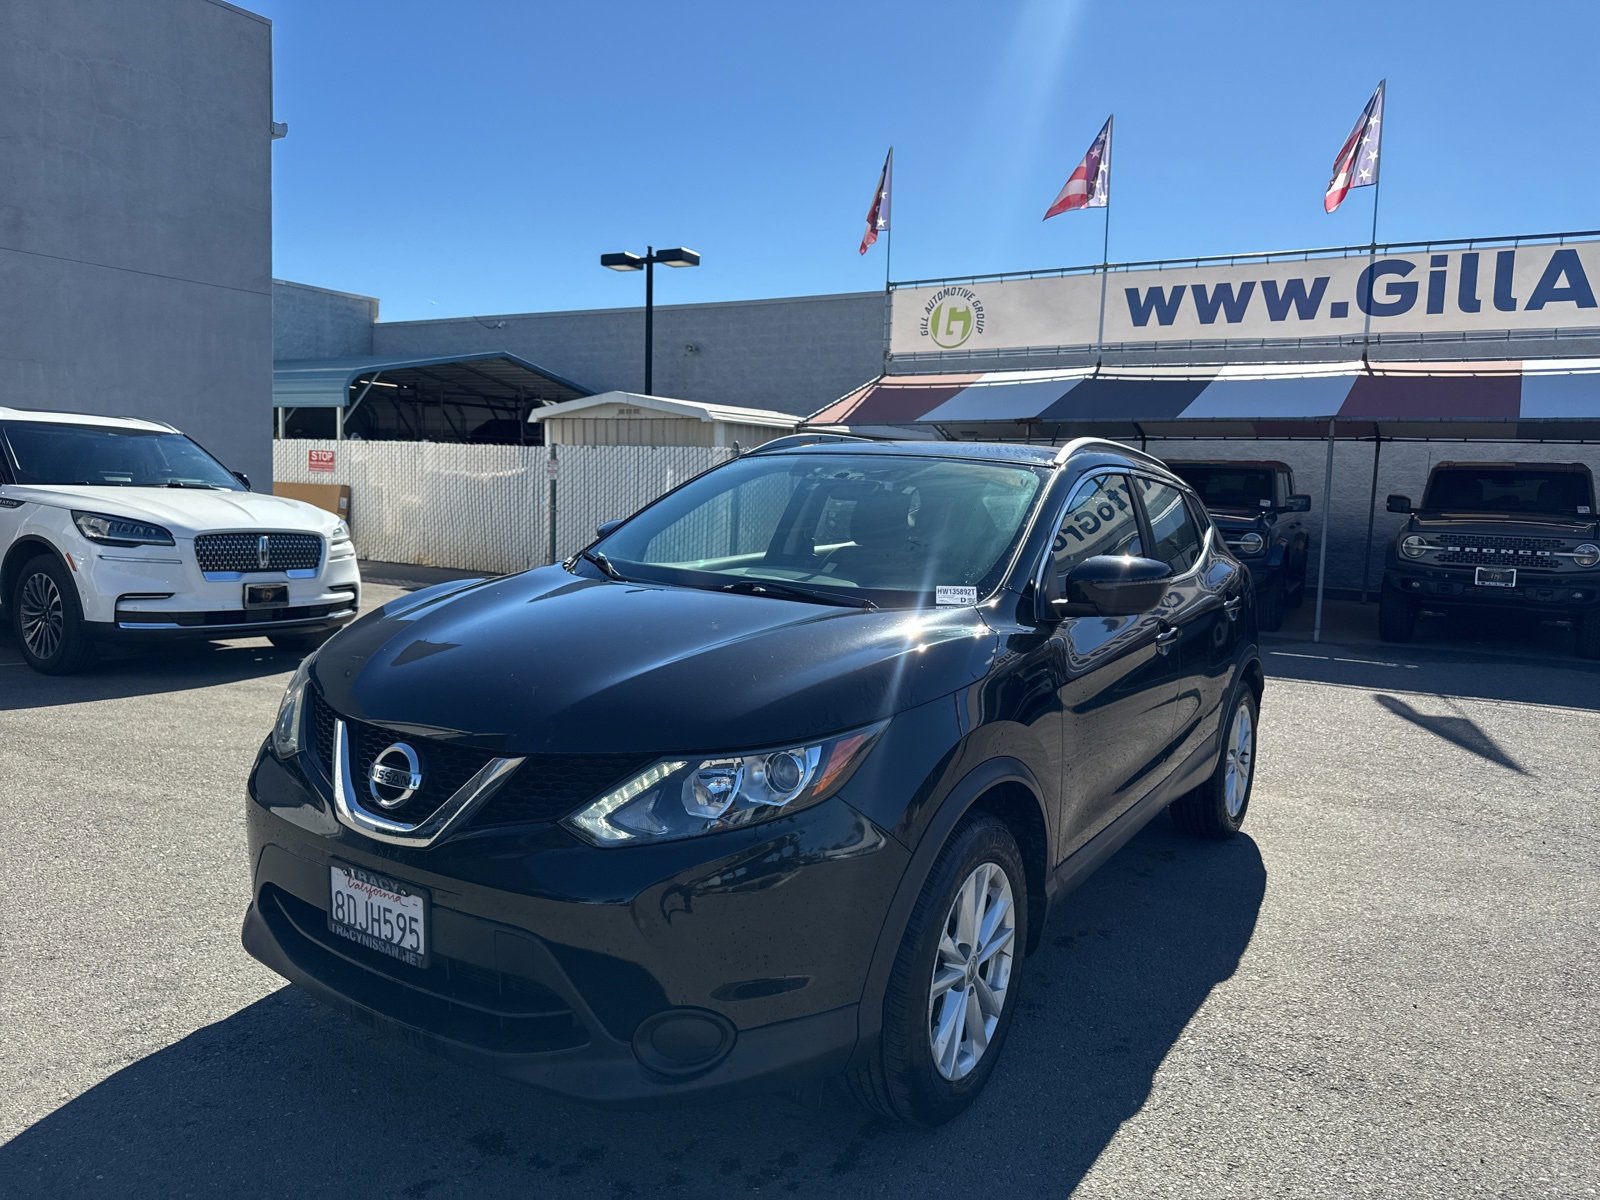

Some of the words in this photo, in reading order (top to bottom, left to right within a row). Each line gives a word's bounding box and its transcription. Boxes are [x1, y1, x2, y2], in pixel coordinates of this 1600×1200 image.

[924, 286, 976, 315] AUTOMOTIVE
[920, 316, 929, 337] GILL
[971, 300, 985, 335] GROUP
[311, 451, 333, 461] STOP
[1447, 546, 1550, 556] BRONCO
[371, 767, 412, 786] NISSAN
[349, 867, 400, 893] TRACY
[335, 890, 420, 952] 8DJH595
